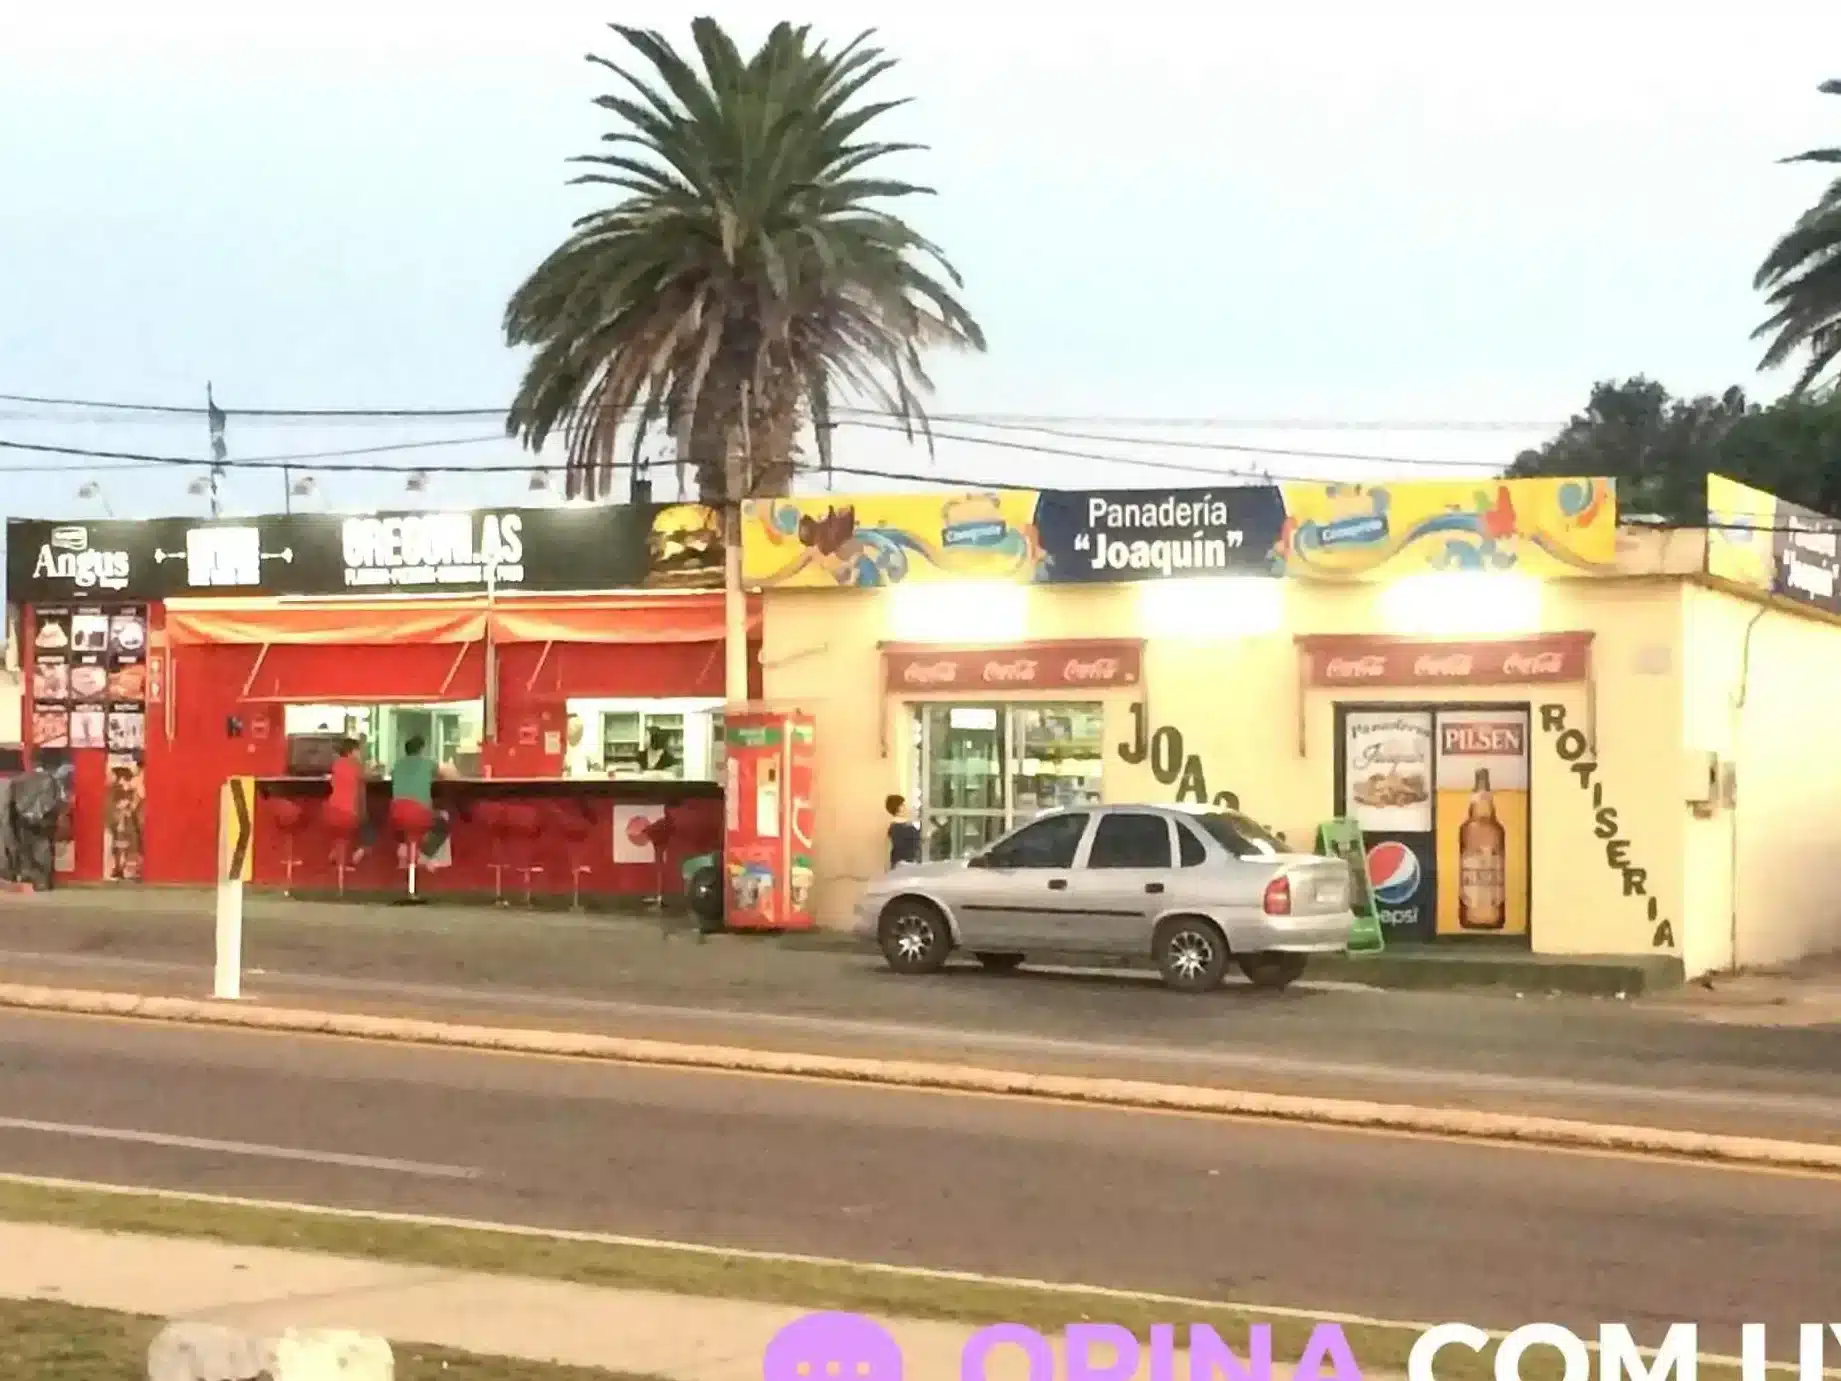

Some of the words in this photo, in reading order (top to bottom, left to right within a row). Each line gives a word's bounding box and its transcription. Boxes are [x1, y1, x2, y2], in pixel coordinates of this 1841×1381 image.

[1088, 493, 1227, 528] Panadería
[32, 544, 130, 587] Angus
[1445, 728, 1521, 751] PILSEN
[1539, 703, 1676, 948] ROTISERIA
[1378, 905, 1419, 927] epsi
